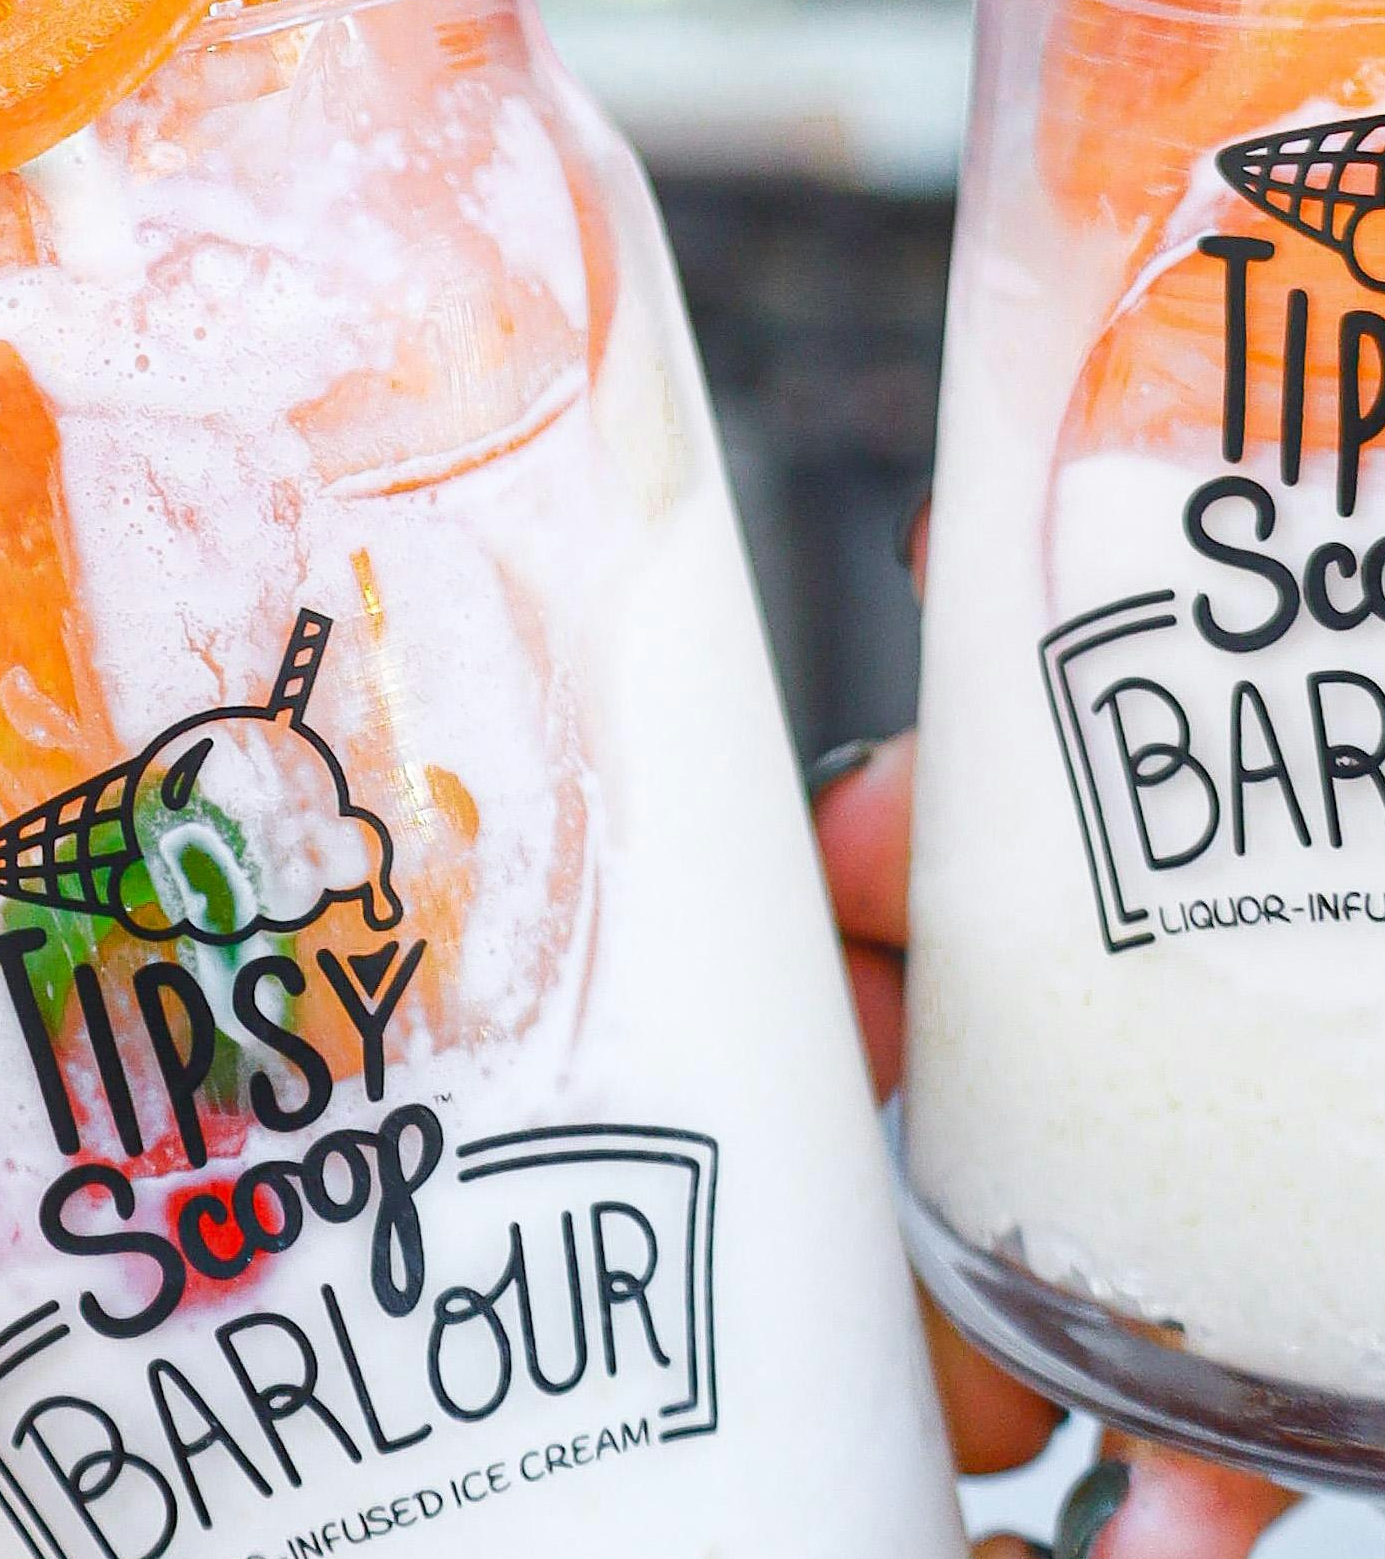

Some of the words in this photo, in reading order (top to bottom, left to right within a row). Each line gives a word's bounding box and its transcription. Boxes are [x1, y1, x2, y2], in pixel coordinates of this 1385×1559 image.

[39, 1100, 444, 1338] Scoop
[449, 1461, 512, 1509] ICE
[519, 1417, 651, 1483] CREAM
